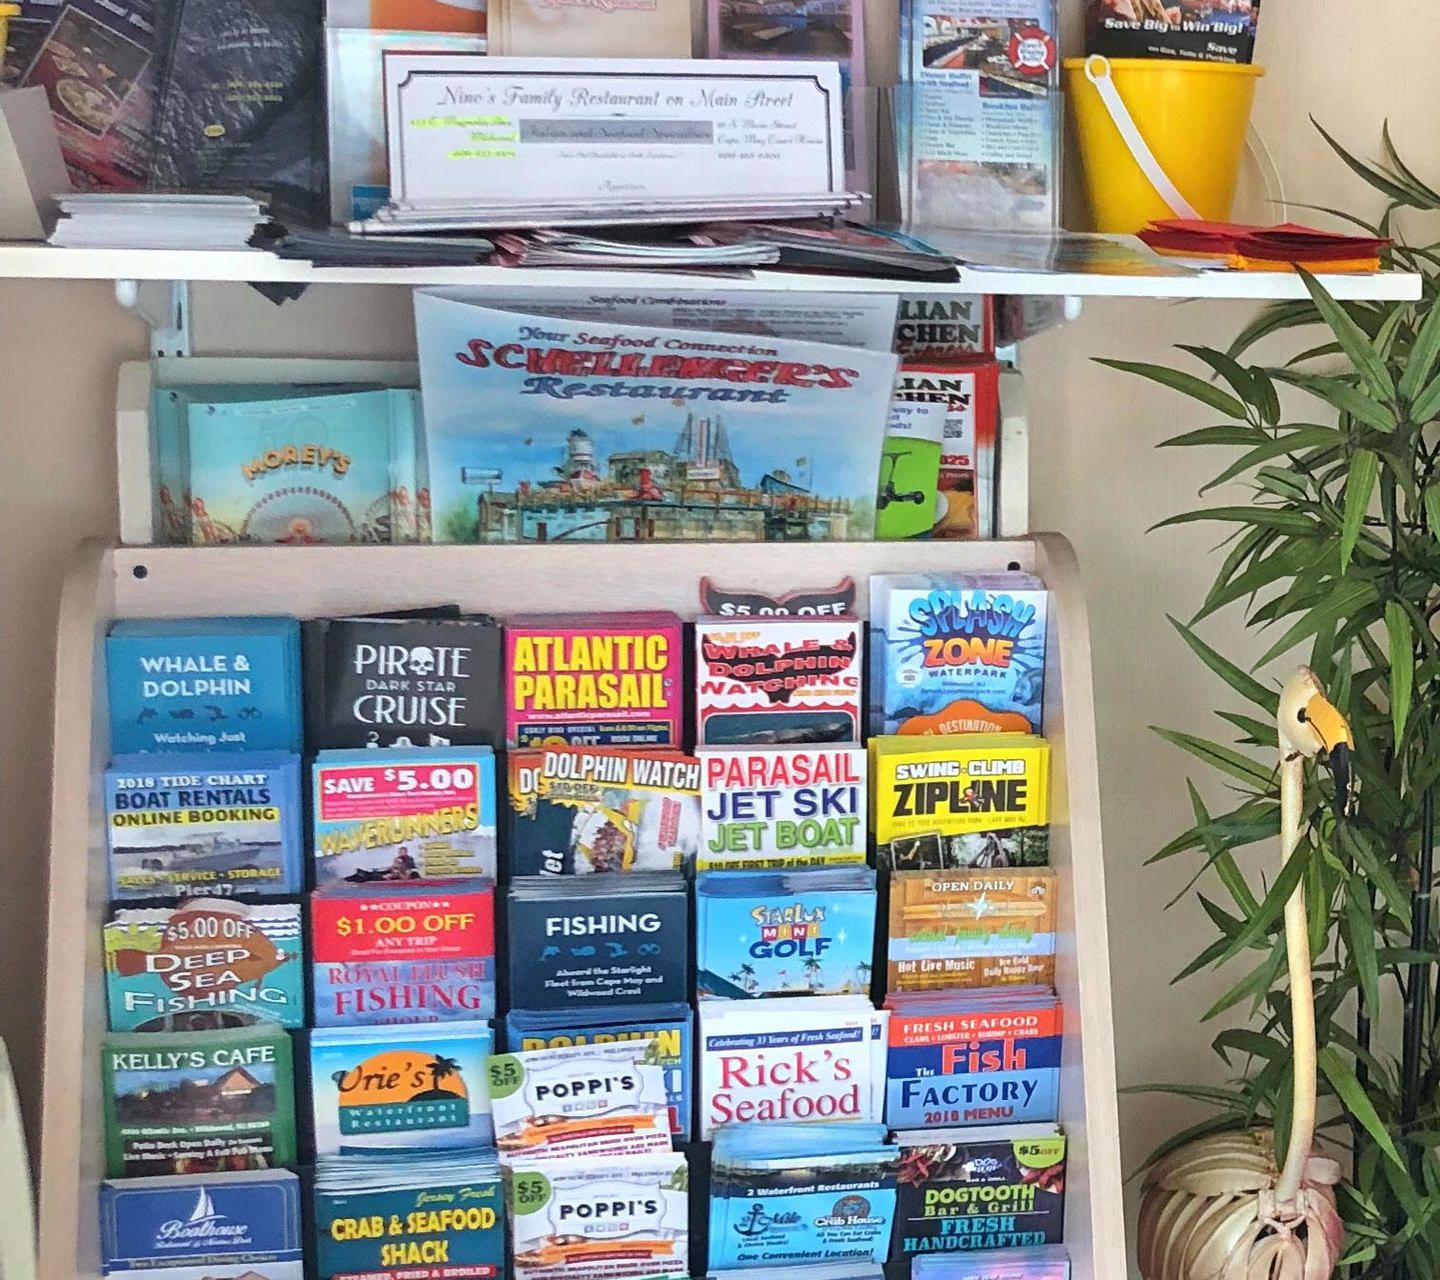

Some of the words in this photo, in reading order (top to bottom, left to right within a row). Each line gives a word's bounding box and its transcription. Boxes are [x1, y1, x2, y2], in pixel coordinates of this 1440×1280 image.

[1105, 17, 1142, 32] Save
[1145, 18, 1169, 35] Big
[1183, 19, 1209, 33] Win
[1210, 22, 1244, 35] Big!
[437, 86, 497, 107] Nino's
[503, 85, 562, 108] Family
[569, 87, 659, 108] Restaurant
[665, 95, 684, 107] on
[690, 90, 738, 108] Main
[744, 91, 795, 108] Street
[519, 326, 570, 343] Your
[573, 333, 659, 350] Seafood
[665, 339, 779, 358] Connection
[521, 377, 792, 405] Restaurant
[241, 444, 350, 481] MOREY'S
[909, 590, 1036, 638] SPLASH
[514, 635, 668, 672] ATLANTIC
[705, 642, 820, 659] WHALE
[831, 639, 853, 651] &
[924, 638, 1015, 668] ZONE
[141, 656, 227, 674] WHALE
[234, 655, 250, 671] &
[709, 657, 850, 677] DOLPHIN
[143, 679, 250, 697] DOLPHIN
[514, 674, 668, 710] PARASAIL
[154, 732, 216, 745] Watching
[219, 731, 246, 743] Just
[707, 753, 861, 788] PARASAIL
[115, 791, 170, 810] BOAT
[179, 789, 271, 807] RENTALS
[707, 791, 781, 821] JET
[793, 787, 858, 817] SKI
[893, 780, 1028, 817] ZIPLINE
[113, 810, 184, 828] ONLINE
[188, 808, 275, 824] BOOKING
[708, 821, 768, 852] JET
[776, 818, 860, 849] BOAT
[932, 881, 969, 893] OPEN
[973, 880, 1014, 891] DAILY
[168, 917, 218, 942] $5.00
[223, 919, 254, 939] OFF
[546, 913, 662, 937] FISHING
[749, 938, 832, 959] GOLF
[145, 949, 251, 974] DEEP
[169, 971, 241, 991] SEA
[124, 988, 288, 1014] FISHING
[335, 984, 480, 1015] FISHING
[903, 1021, 955, 1034] FRESH
[960, 1015, 1039, 1029] SEAFOOD
[112, 1051, 205, 1070] KELLY'S
[213, 1046, 275, 1066] CAFE
[719, 1049, 852, 1090] Rick's
[942, 1040, 1027, 1074] Fish
[536, 1076, 634, 1101] POPPI'S
[901, 1079, 1038, 1109] FACTORY
[710, 1084, 862, 1125] Seafood
[747, 1189, 754, 1197] 2
[757, 1186, 815, 1197] Waterfront
[817, 1181, 880, 1194] Restaurants
[925, 1184, 1036, 1206] DOGTOOTH
[559, 1199, 658, 1220] POPPI'S
[331, 1216, 385, 1241] CRAB
[389, 1217, 403, 1233] &
[407, 1208, 496, 1232] SEAFOOD
[381, 1239, 449, 1267] SHACK
